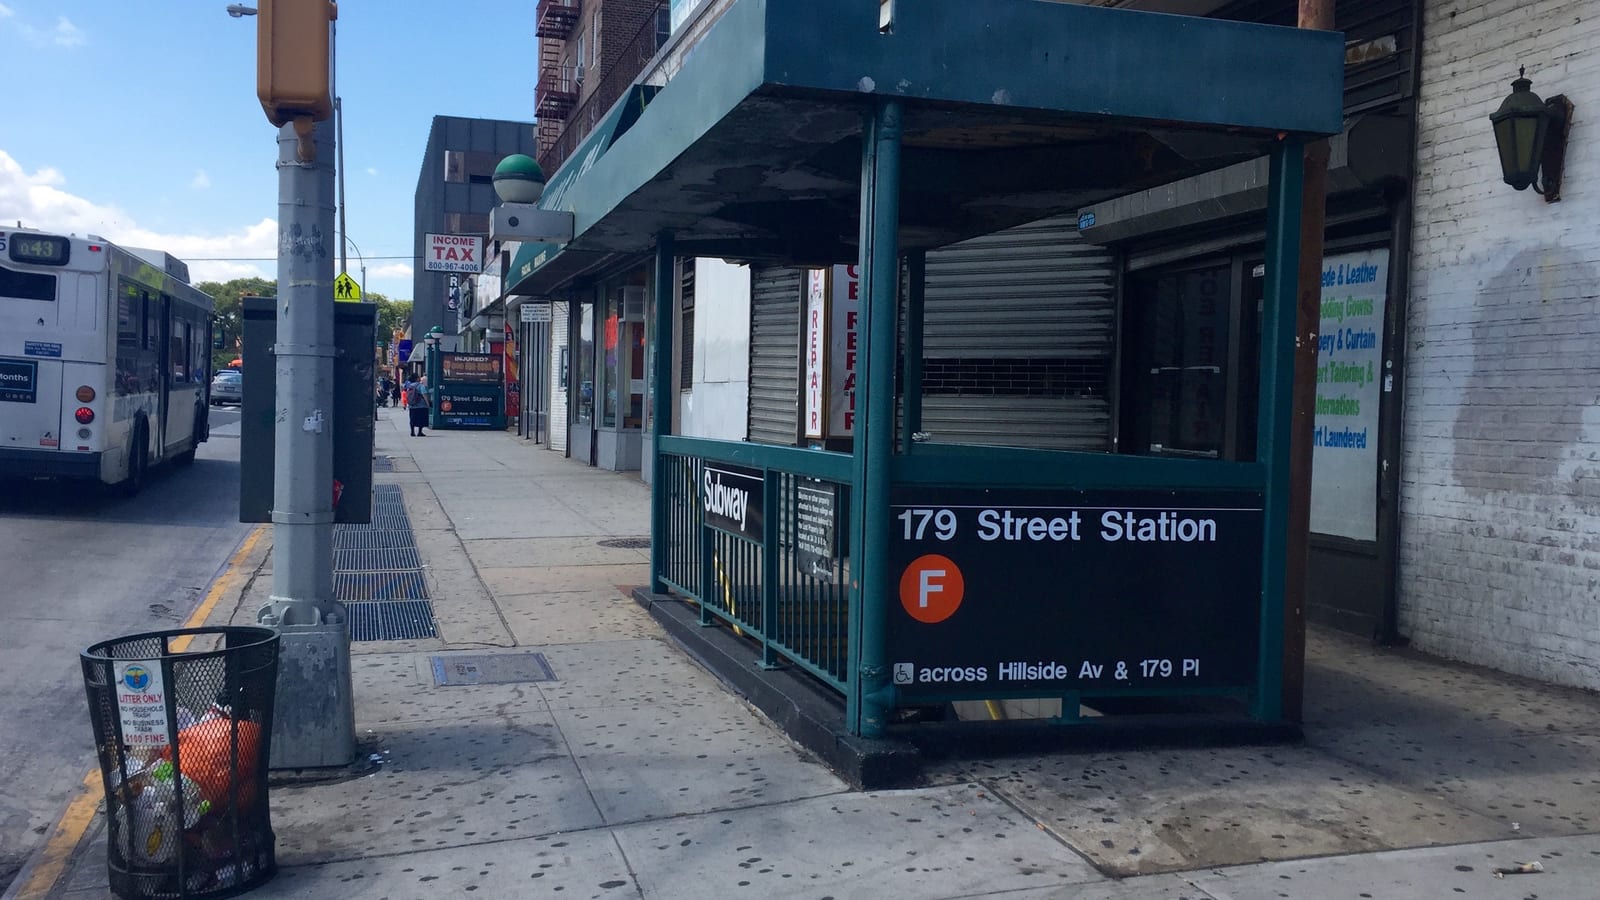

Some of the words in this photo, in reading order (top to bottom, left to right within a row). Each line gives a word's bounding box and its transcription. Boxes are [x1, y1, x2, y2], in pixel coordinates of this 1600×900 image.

[433, 236, 475, 246] INCOME
[433, 246, 474, 262] TAX
[428, 261, 479, 272] 800-967-4006
[1321, 265, 1335, 287] ede
[1338, 263, 1344, 285] &
[1345, 261, 1378, 285] Leather
[1346, 296, 1374, 317] Gowns
[1337, 328, 1343, 350] &
[1345, 327, 1376, 350] Curtain
[1329, 361, 1365, 388] Tailoring
[1324, 425, 1367, 448] Laundered
[704, 470, 748, 531] Subway
[897, 509, 958, 541] 179
[976, 509, 1081, 541] Street
[1100, 510, 1217, 542] Station
[919, 569, 946, 608] F
[919, 663, 988, 682] across
[998, 661, 1067, 680] Hillside
[1079, 660, 1104, 679] Av
[1114, 661, 1129, 680] &
[1139, 659, 1173, 677] 179
[1182, 658, 1200, 676] Pl
[120, 694, 141, 703] LITTER
[143, 694, 162, 703] ONLY
[132, 719, 164, 727] BUSINESS
[125, 733, 143, 743] $100
[145, 733, 165, 743] FINE
